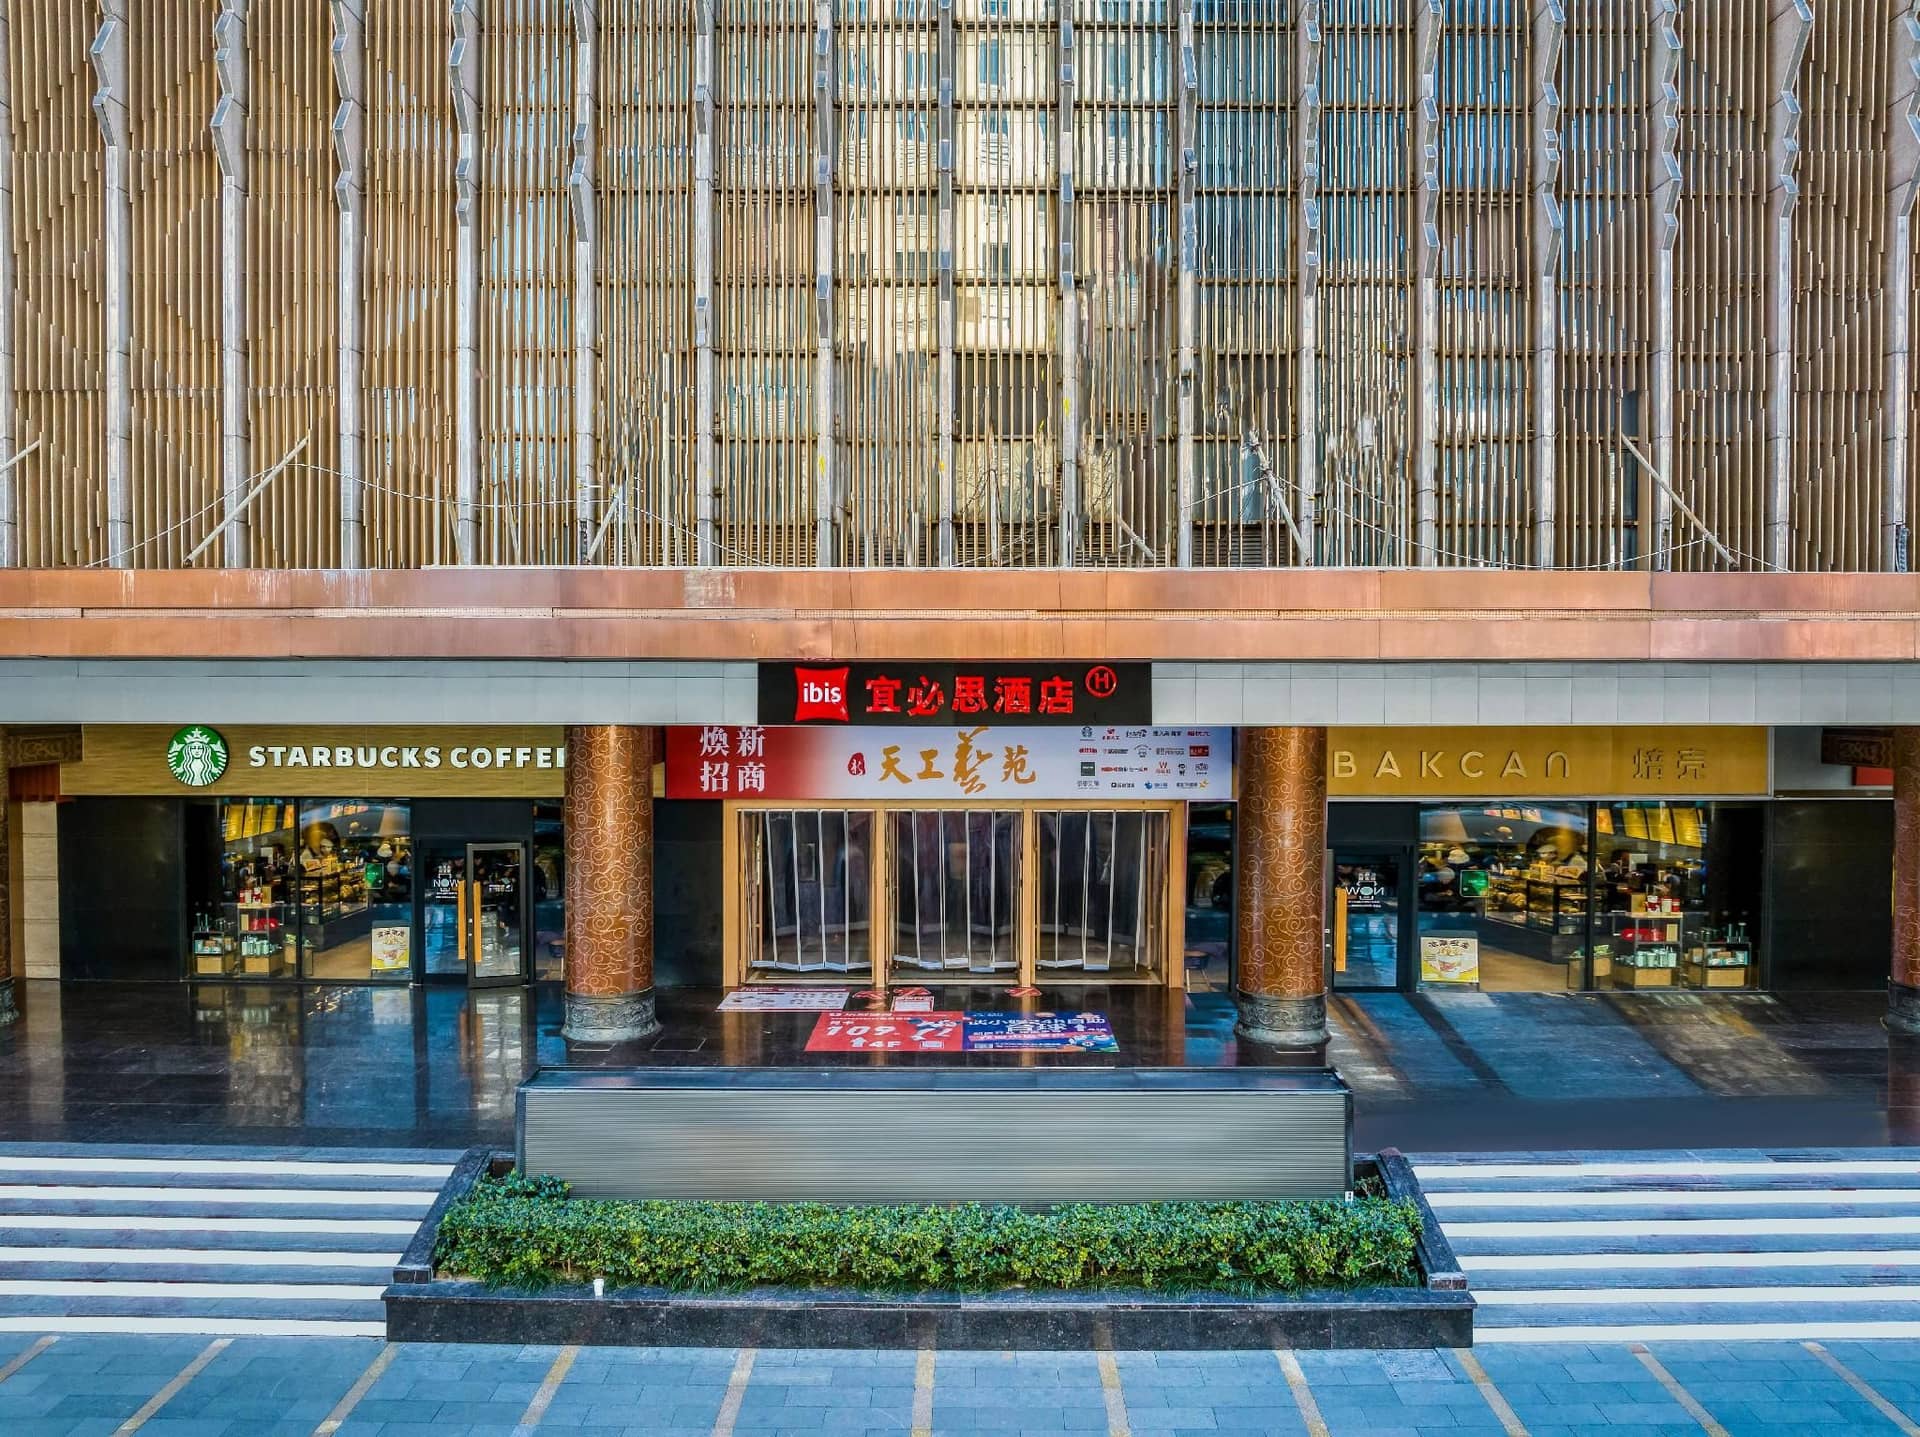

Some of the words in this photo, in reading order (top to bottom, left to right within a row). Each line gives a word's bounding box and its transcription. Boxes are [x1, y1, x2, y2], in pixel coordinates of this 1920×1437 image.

[803, 682, 842, 704] ibis
[865, 675, 1074, 717] 宜必思酒店
[249, 745, 442, 769] STARBUCKS
[699, 761, 768, 793] 招商
